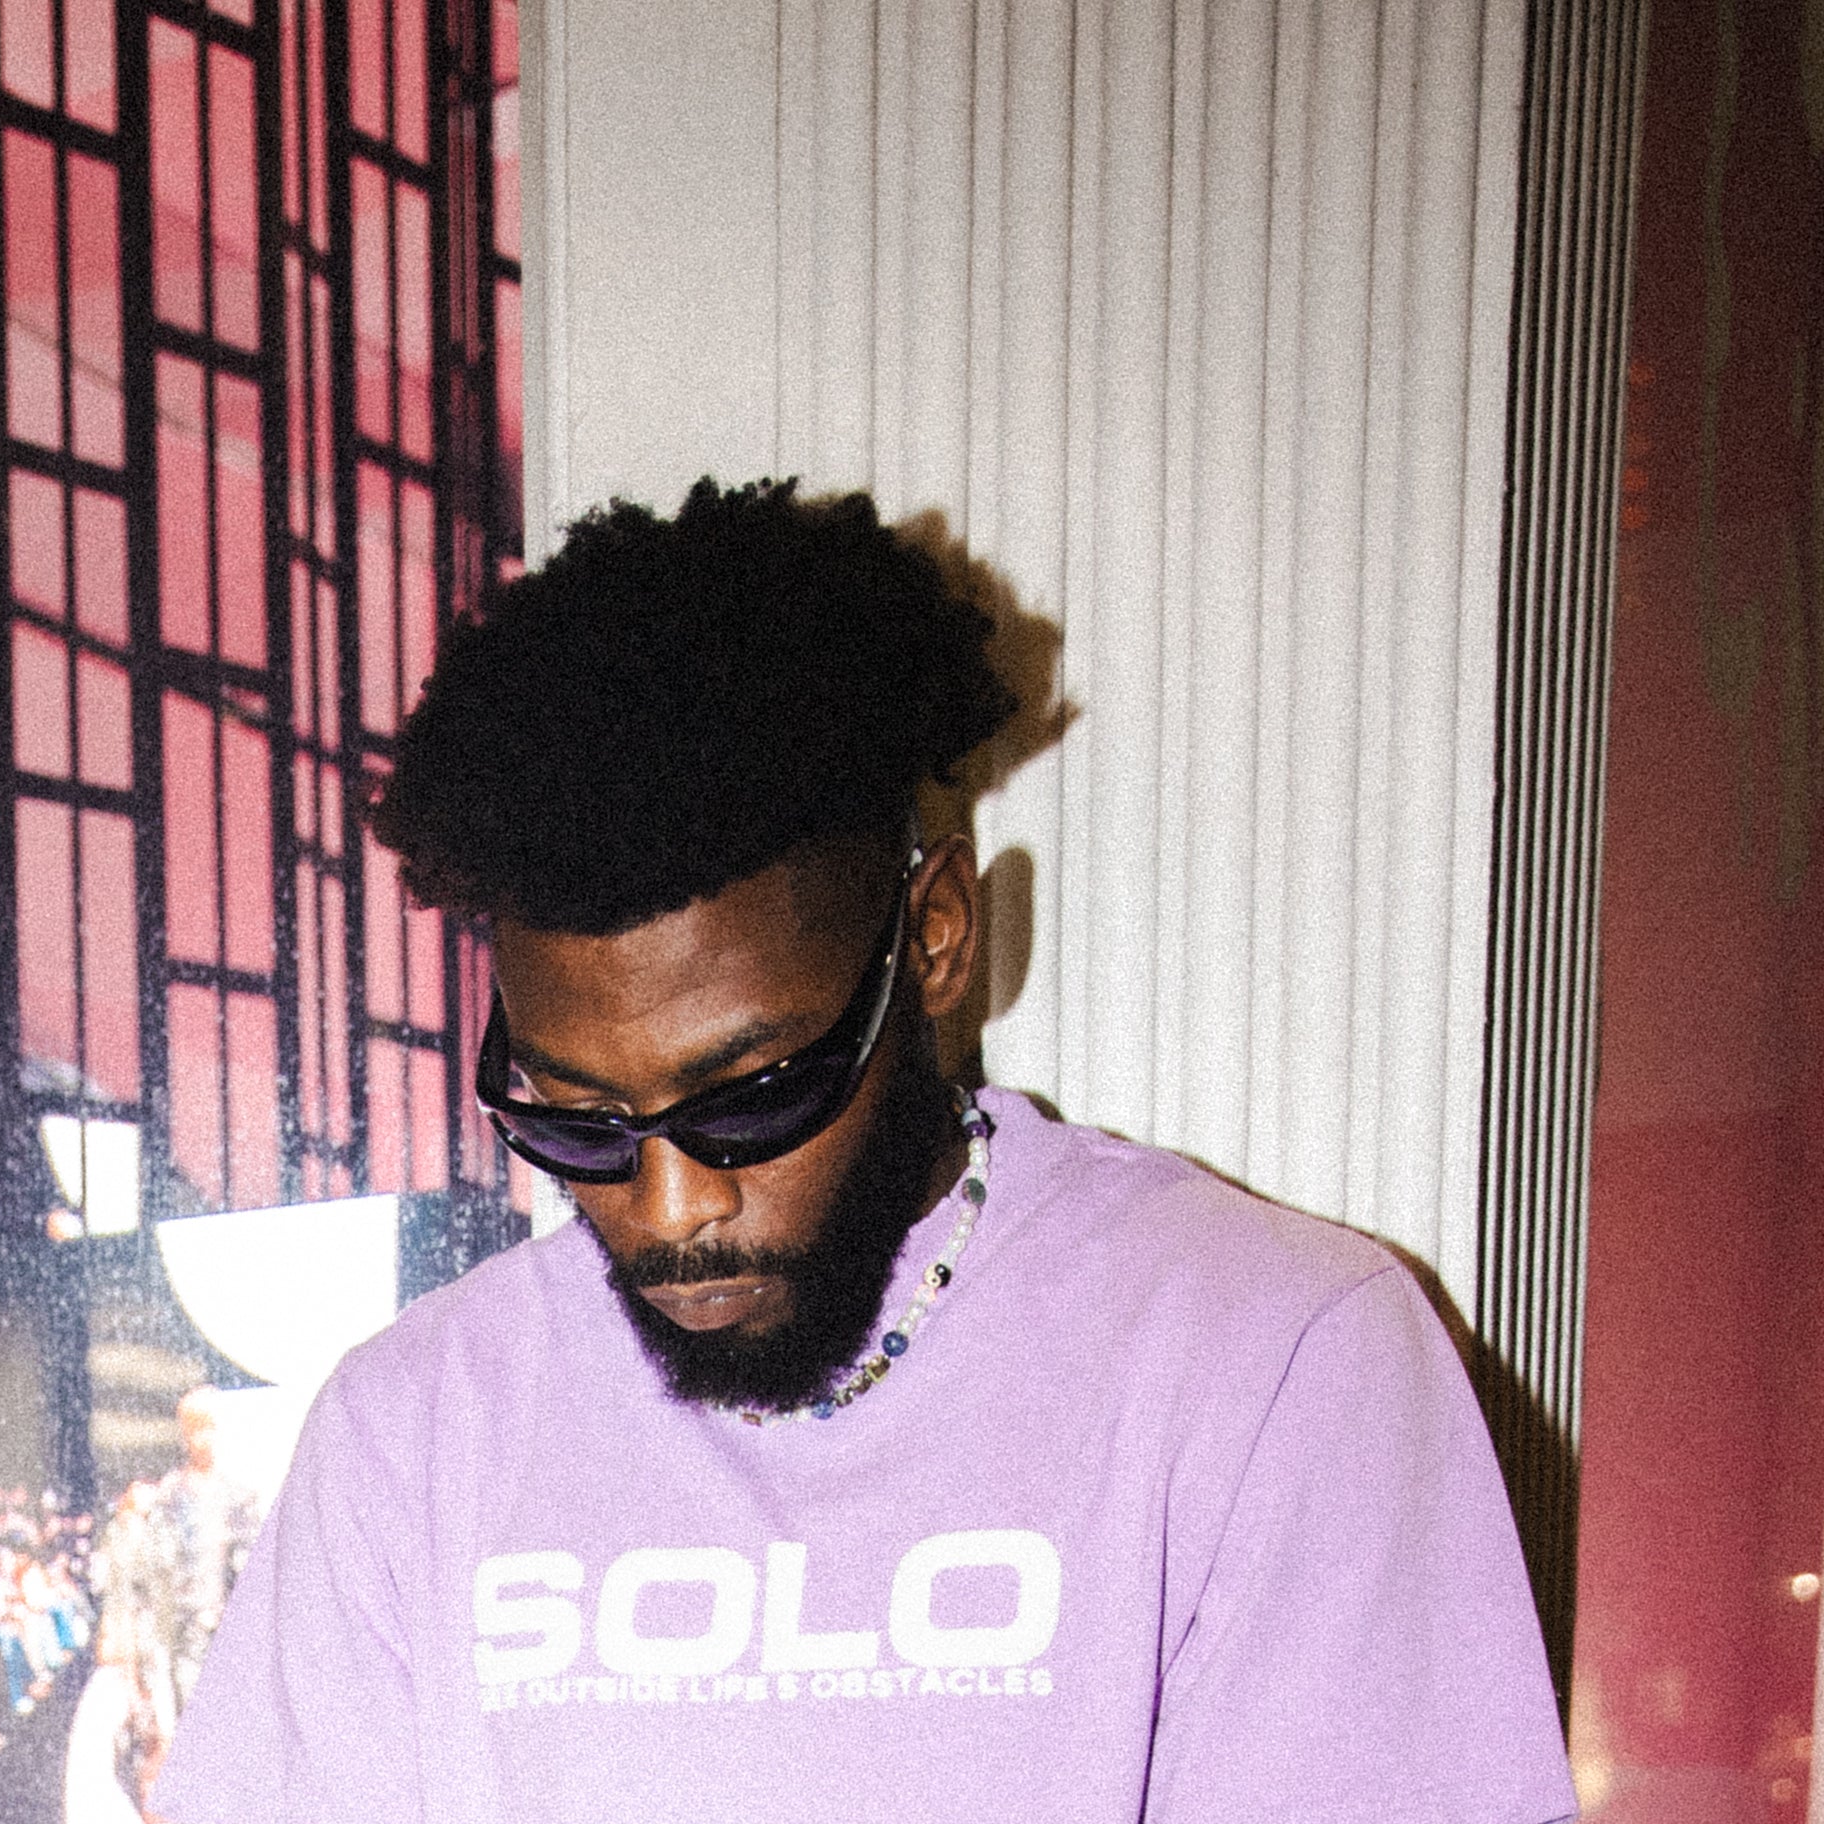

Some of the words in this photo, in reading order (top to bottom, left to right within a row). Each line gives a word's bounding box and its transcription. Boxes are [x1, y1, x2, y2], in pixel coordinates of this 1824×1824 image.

[475, 1528, 1062, 1684] SOLO
[525, 1675, 679, 1706] OUTSIDE
[811, 1667, 1053, 1698] OBSTACLES
